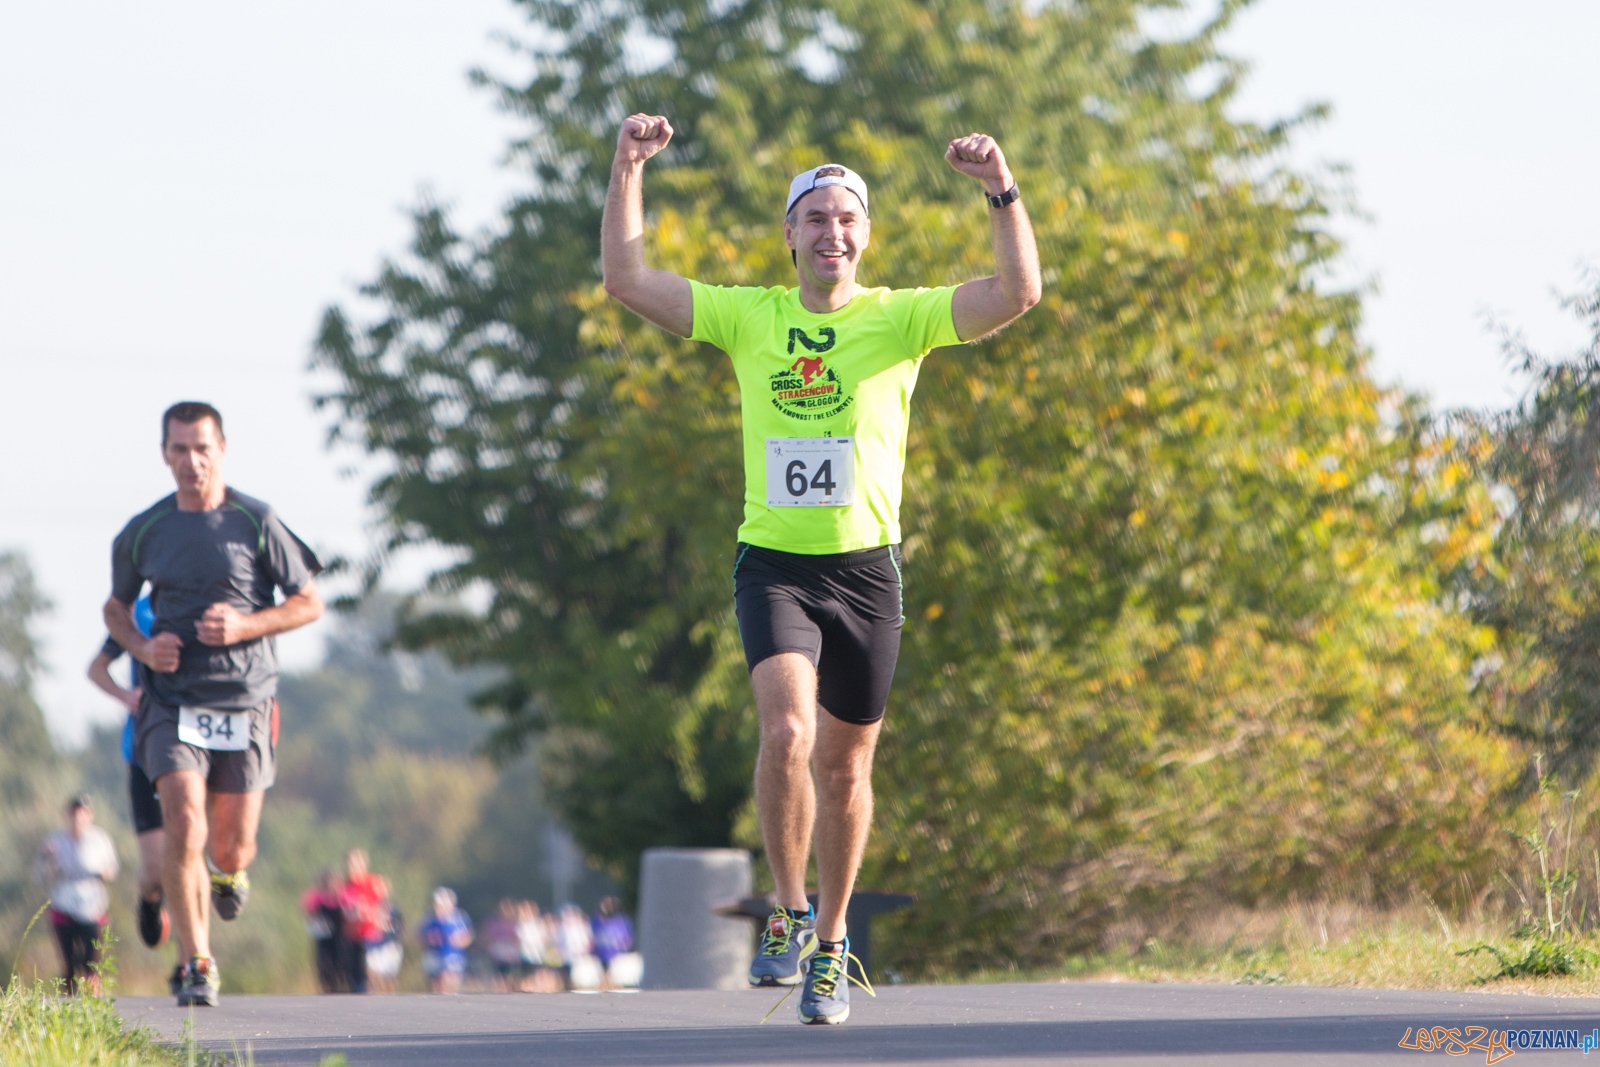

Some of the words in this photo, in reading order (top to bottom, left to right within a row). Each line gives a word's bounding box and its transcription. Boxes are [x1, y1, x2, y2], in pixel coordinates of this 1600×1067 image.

[771, 379, 803, 391] CROSS
[778, 383, 835, 400] STRACEŃCÓW
[771, 398, 783, 411] MAN
[782, 408, 811, 420] AMONGST
[825, 395, 854, 418] ELEMENTS
[807, 395, 840, 408] GŁOGÓW
[785, 459, 836, 497] 64
[197, 714, 234, 741] 84
